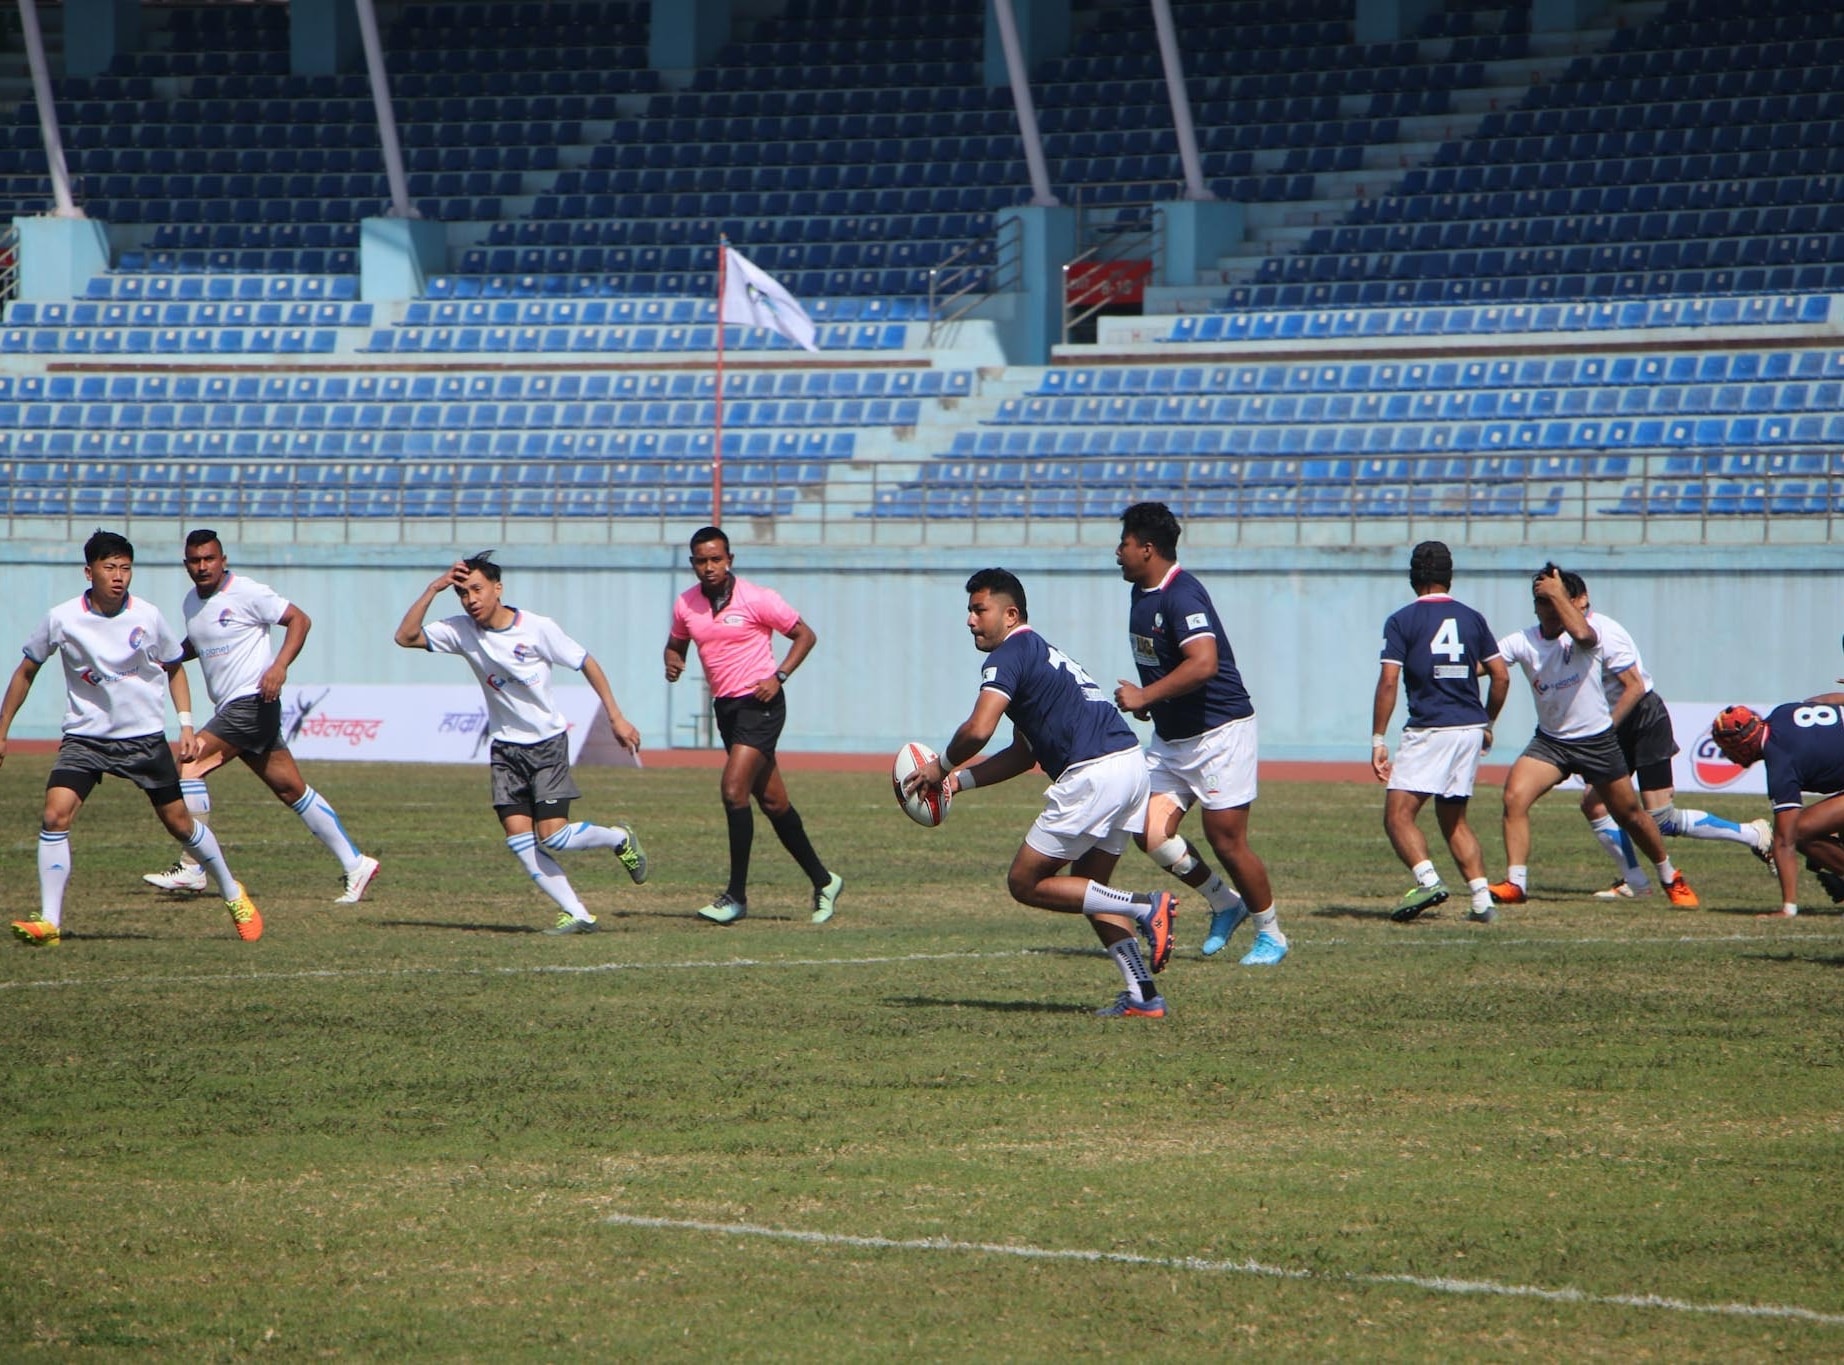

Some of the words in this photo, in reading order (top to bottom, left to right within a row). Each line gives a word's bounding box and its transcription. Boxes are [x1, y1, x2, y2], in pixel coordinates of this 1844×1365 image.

[1430, 618, 1465, 662] 4
[302, 713, 384, 746] खेलकुद
[1793, 705, 1838, 728] 8
